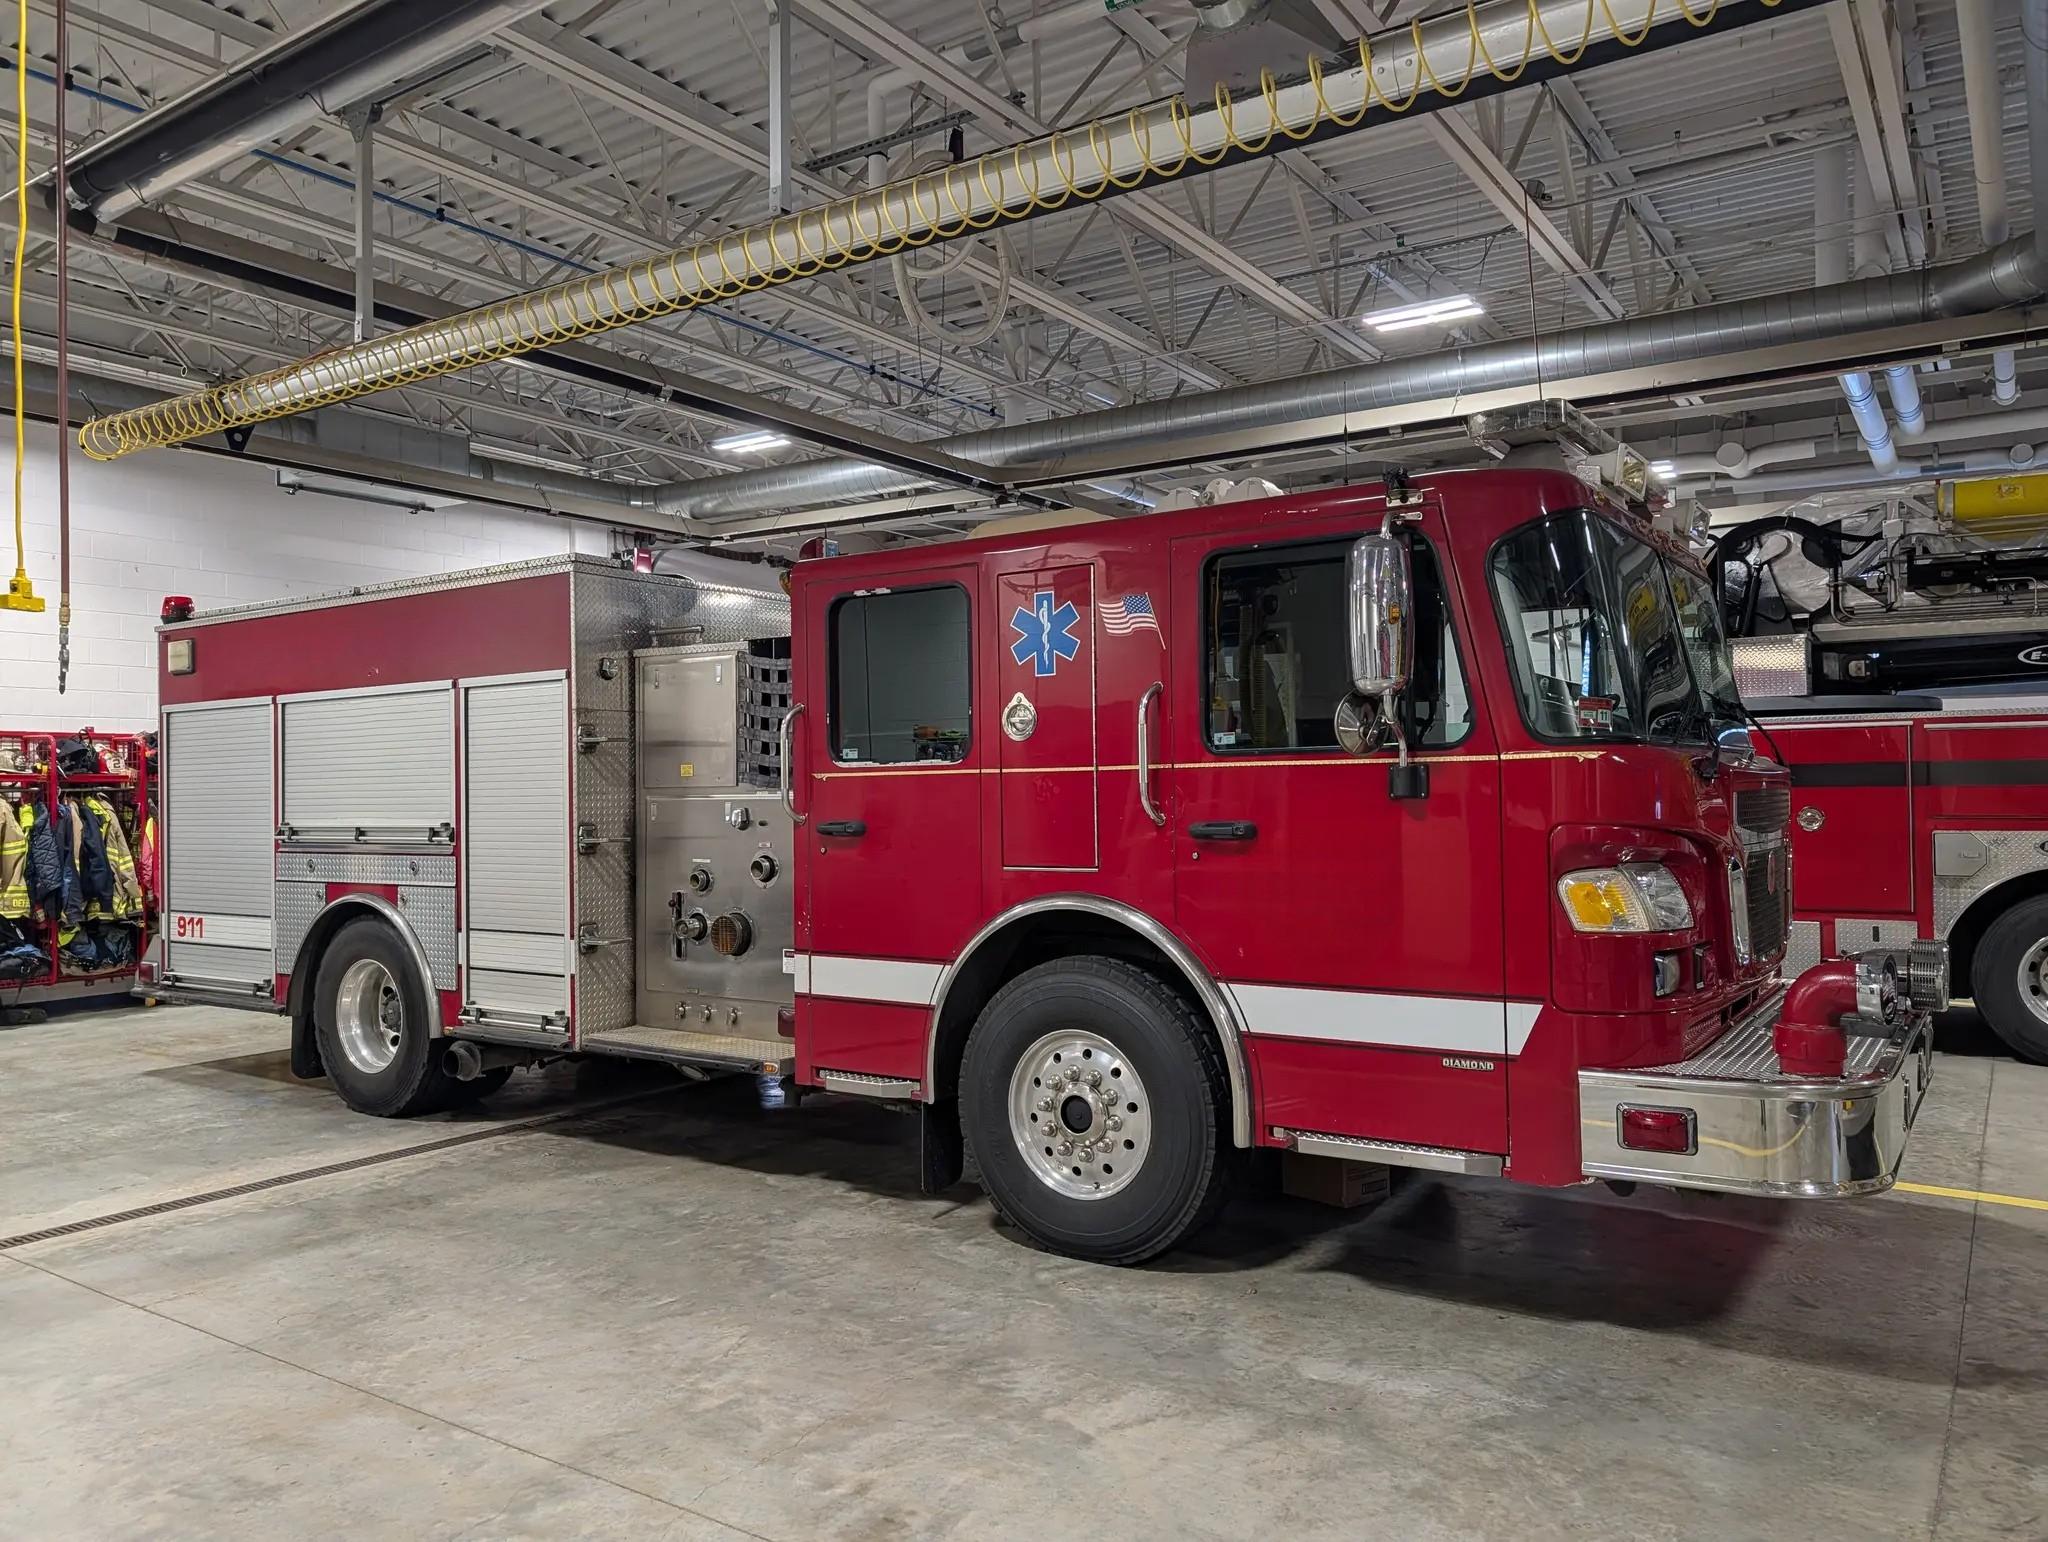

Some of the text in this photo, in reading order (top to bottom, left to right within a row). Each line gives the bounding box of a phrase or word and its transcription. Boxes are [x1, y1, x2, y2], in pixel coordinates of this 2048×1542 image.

[1600, 711, 1608, 721] 11
[112, 759, 121, 769] 2
[177, 915, 204, 939] 911
[1442, 1057, 1495, 1071] DIAMOND
